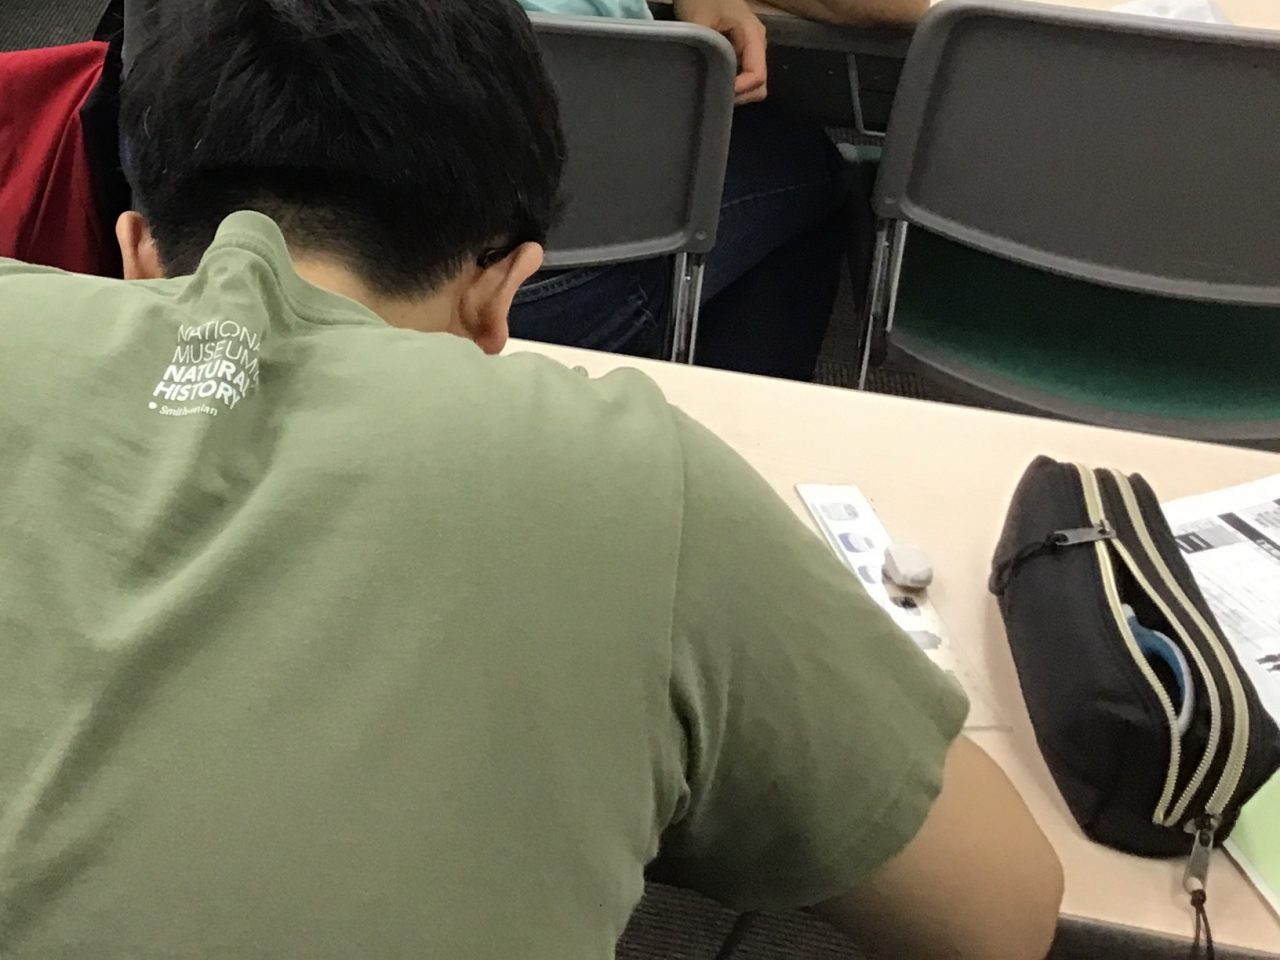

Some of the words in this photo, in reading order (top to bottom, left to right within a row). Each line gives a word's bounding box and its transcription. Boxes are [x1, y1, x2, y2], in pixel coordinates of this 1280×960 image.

[172, 340, 257, 374] MUSEUM
[153, 380, 240, 409] HISTORY
[163, 359, 246, 398] NATURAL
